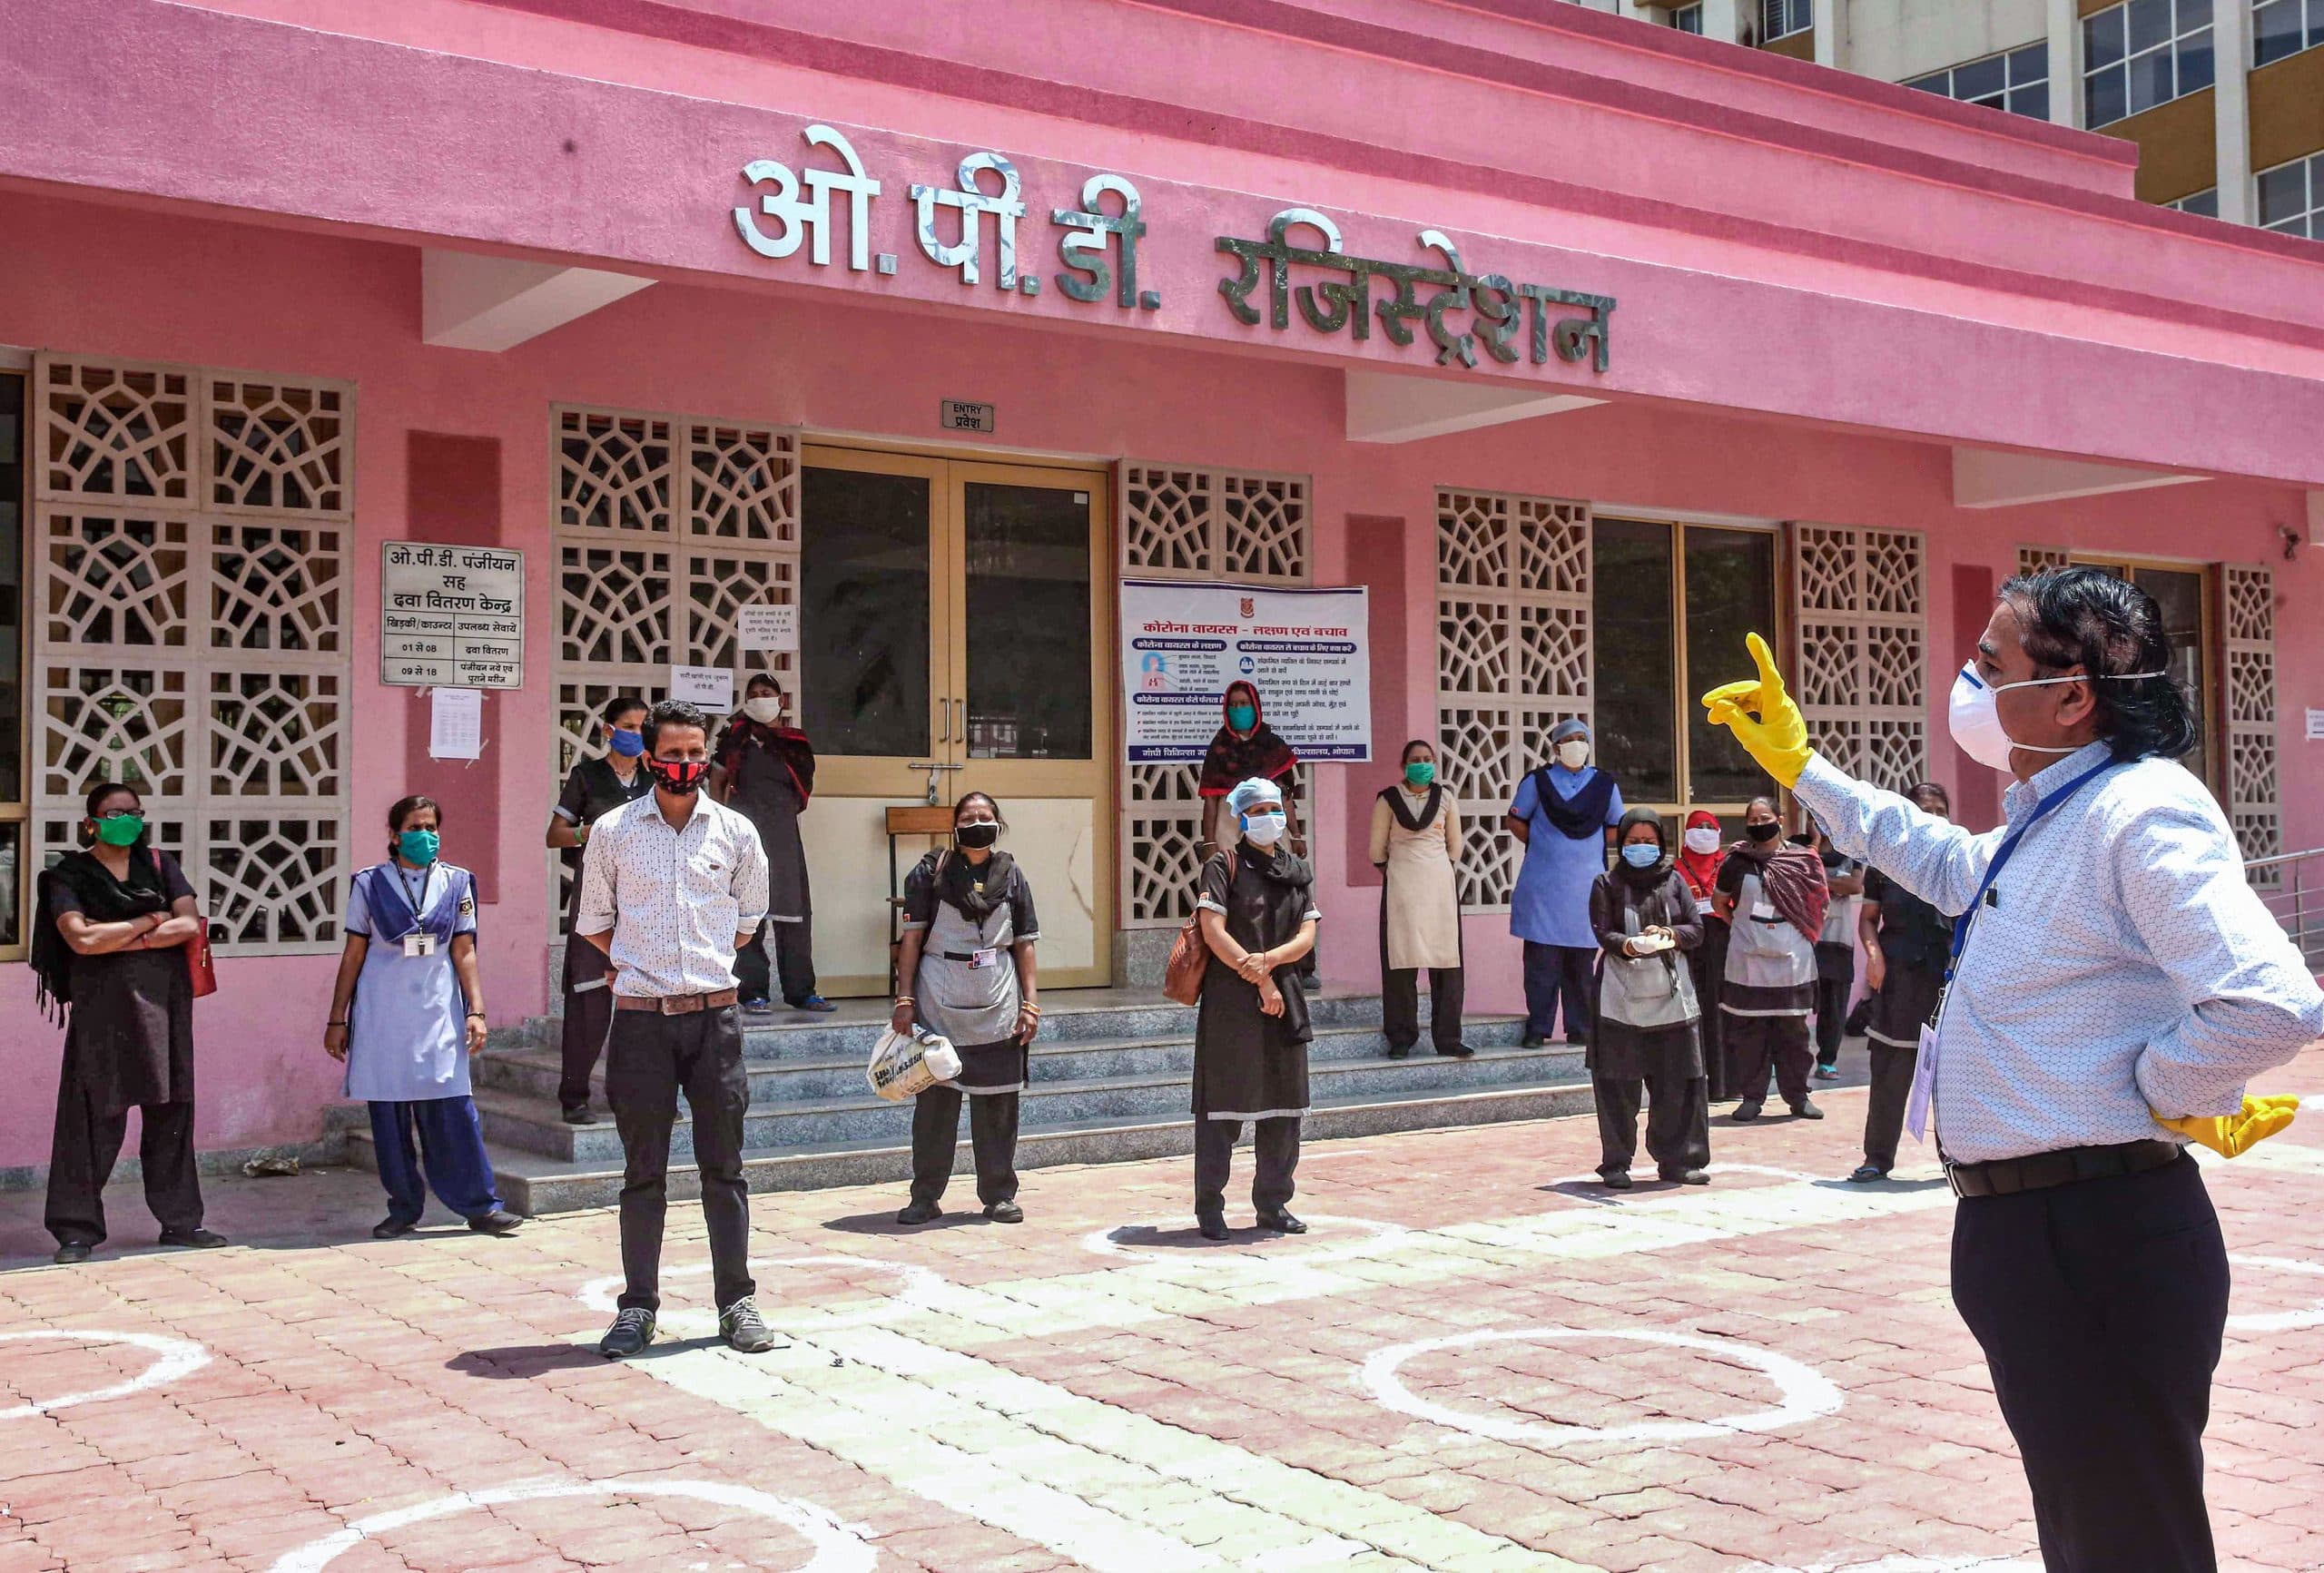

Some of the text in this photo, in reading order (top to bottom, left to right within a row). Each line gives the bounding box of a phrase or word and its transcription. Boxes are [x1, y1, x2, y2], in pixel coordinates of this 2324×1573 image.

[1215, 208, 1617, 373] रजिस्ट्रेशन
[953, 404, 982, 415] ENTRY
[955, 414, 981, 429] प्रवेश
[463, 552, 516, 571] पंजीयन
[443, 575, 466, 591] सह
[393, 590, 512, 614] दवा वितरण केन्द्र
[458, 622, 489, 632] उपलब्ध
[1143, 620, 1189, 634] कोरोना
[1192, 624, 1238, 634] वायरस
[1253, 626, 1289, 635] लक्षण
[1292, 625, 1312, 637] एवं
[1314, 627, 1348, 636] बचाव
[416, 642, 423, 653] से
[427, 644, 437, 653] 08
[483, 644, 508, 655] वितरण
[1137, 640, 1163, 649] कोरोना
[1165, 642, 1190, 650] वायरस
[1240, 642, 1262, 651] कोरोना
[415, 665, 423, 676] से
[427, 668, 437, 676] 18
[460, 663, 487, 672] पंजीयन
[503, 664, 513, 673] एवं
[468, 673, 506, 684] पुराने मरीज
[1137, 694, 1160, 703] कोरोना
[1333, 746, 1355, 755] भोपाल
